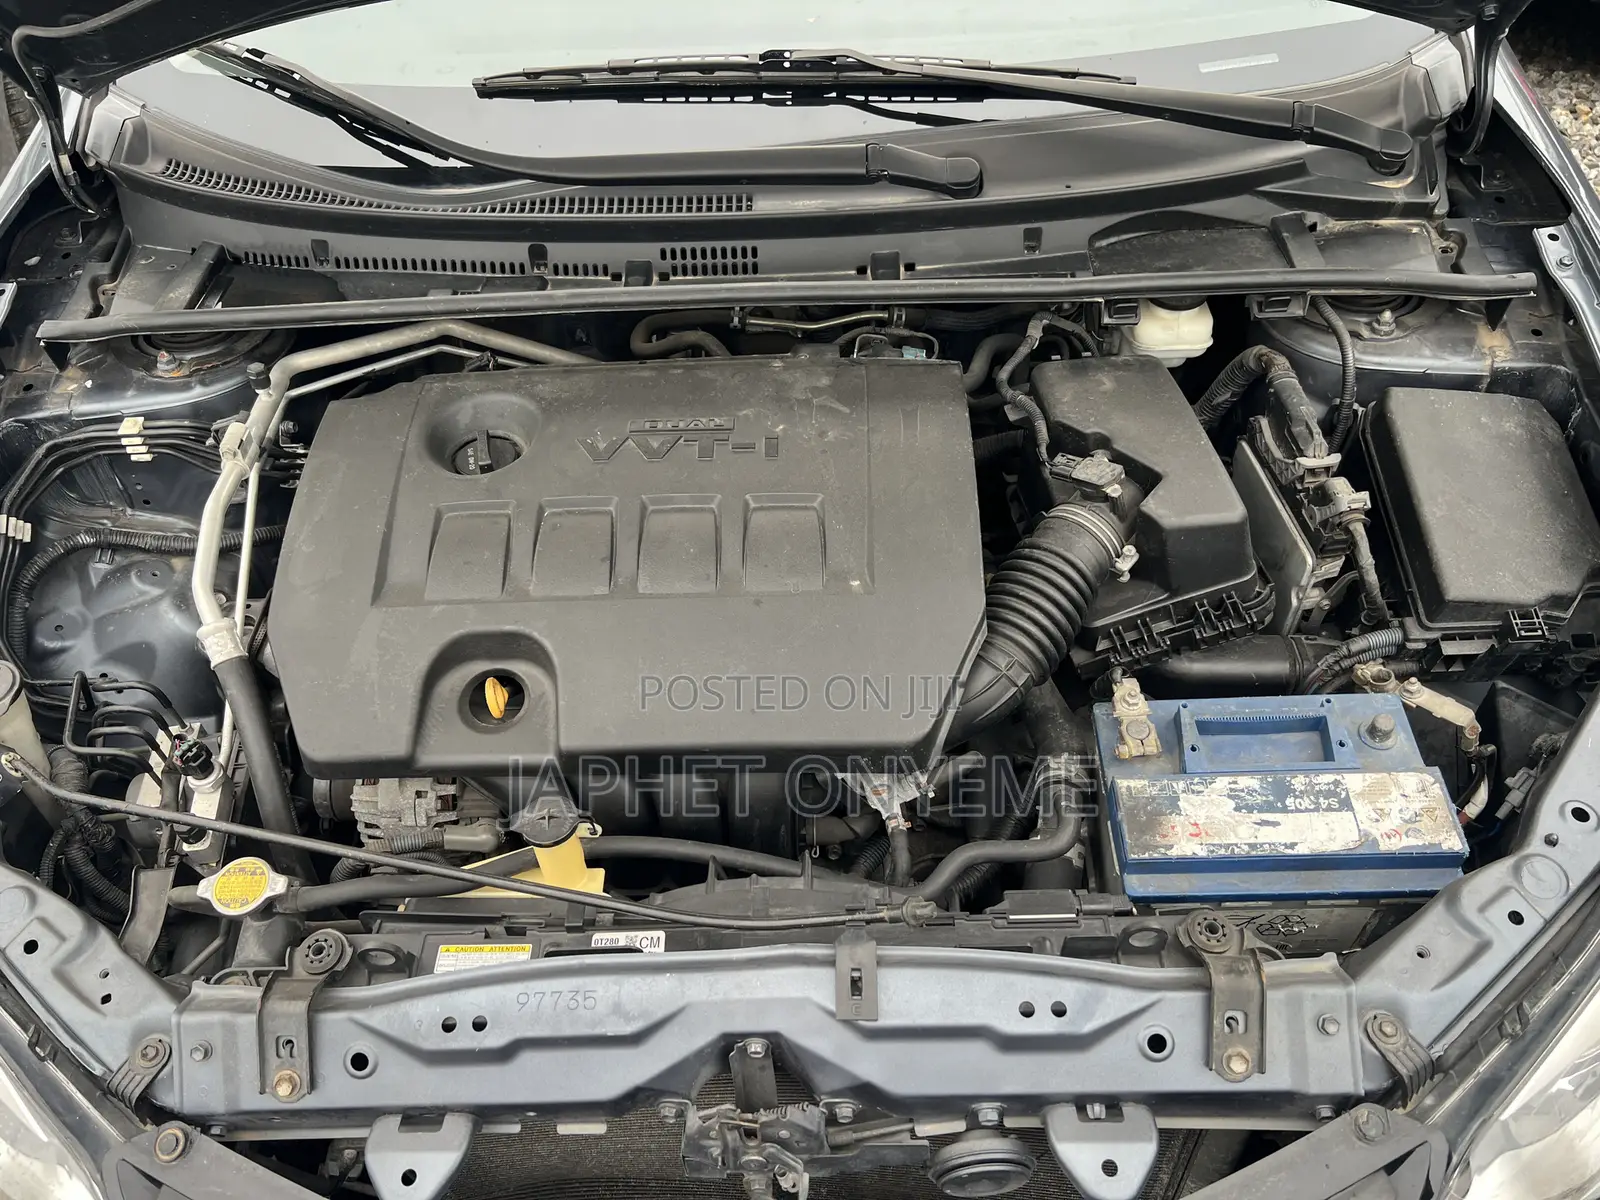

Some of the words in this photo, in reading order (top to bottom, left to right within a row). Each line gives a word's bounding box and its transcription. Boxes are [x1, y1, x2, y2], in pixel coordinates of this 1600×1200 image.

[643, 418, 725, 429] DUAL
[1318, 797, 1340, 809] S4
[639, 936, 661, 949] CM
[488, 945, 526, 953] ATTENTION
[516, 989, 598, 1013] 97735
